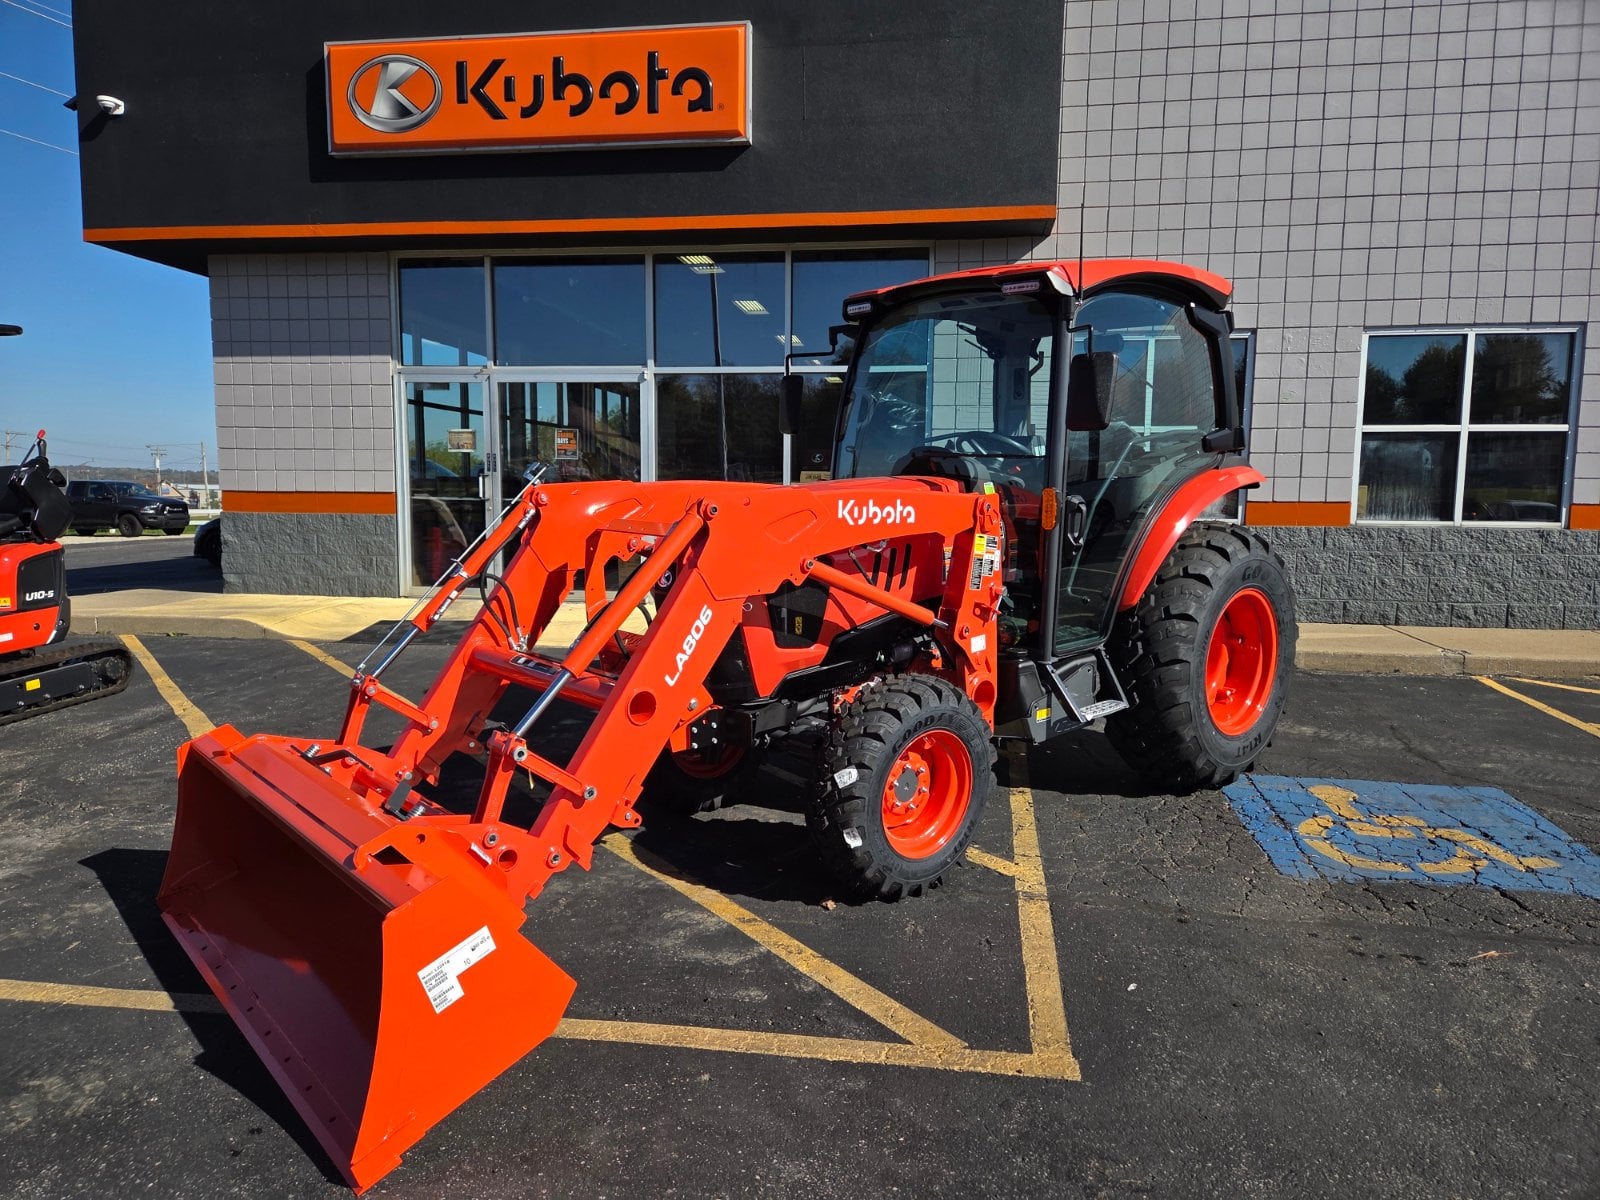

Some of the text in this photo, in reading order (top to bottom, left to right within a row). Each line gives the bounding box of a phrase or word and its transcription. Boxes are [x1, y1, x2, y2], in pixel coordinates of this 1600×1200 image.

[456, 50, 714, 120] Kubota
[837, 498, 916, 526] Kubota
[664, 604, 713, 687] LA806
